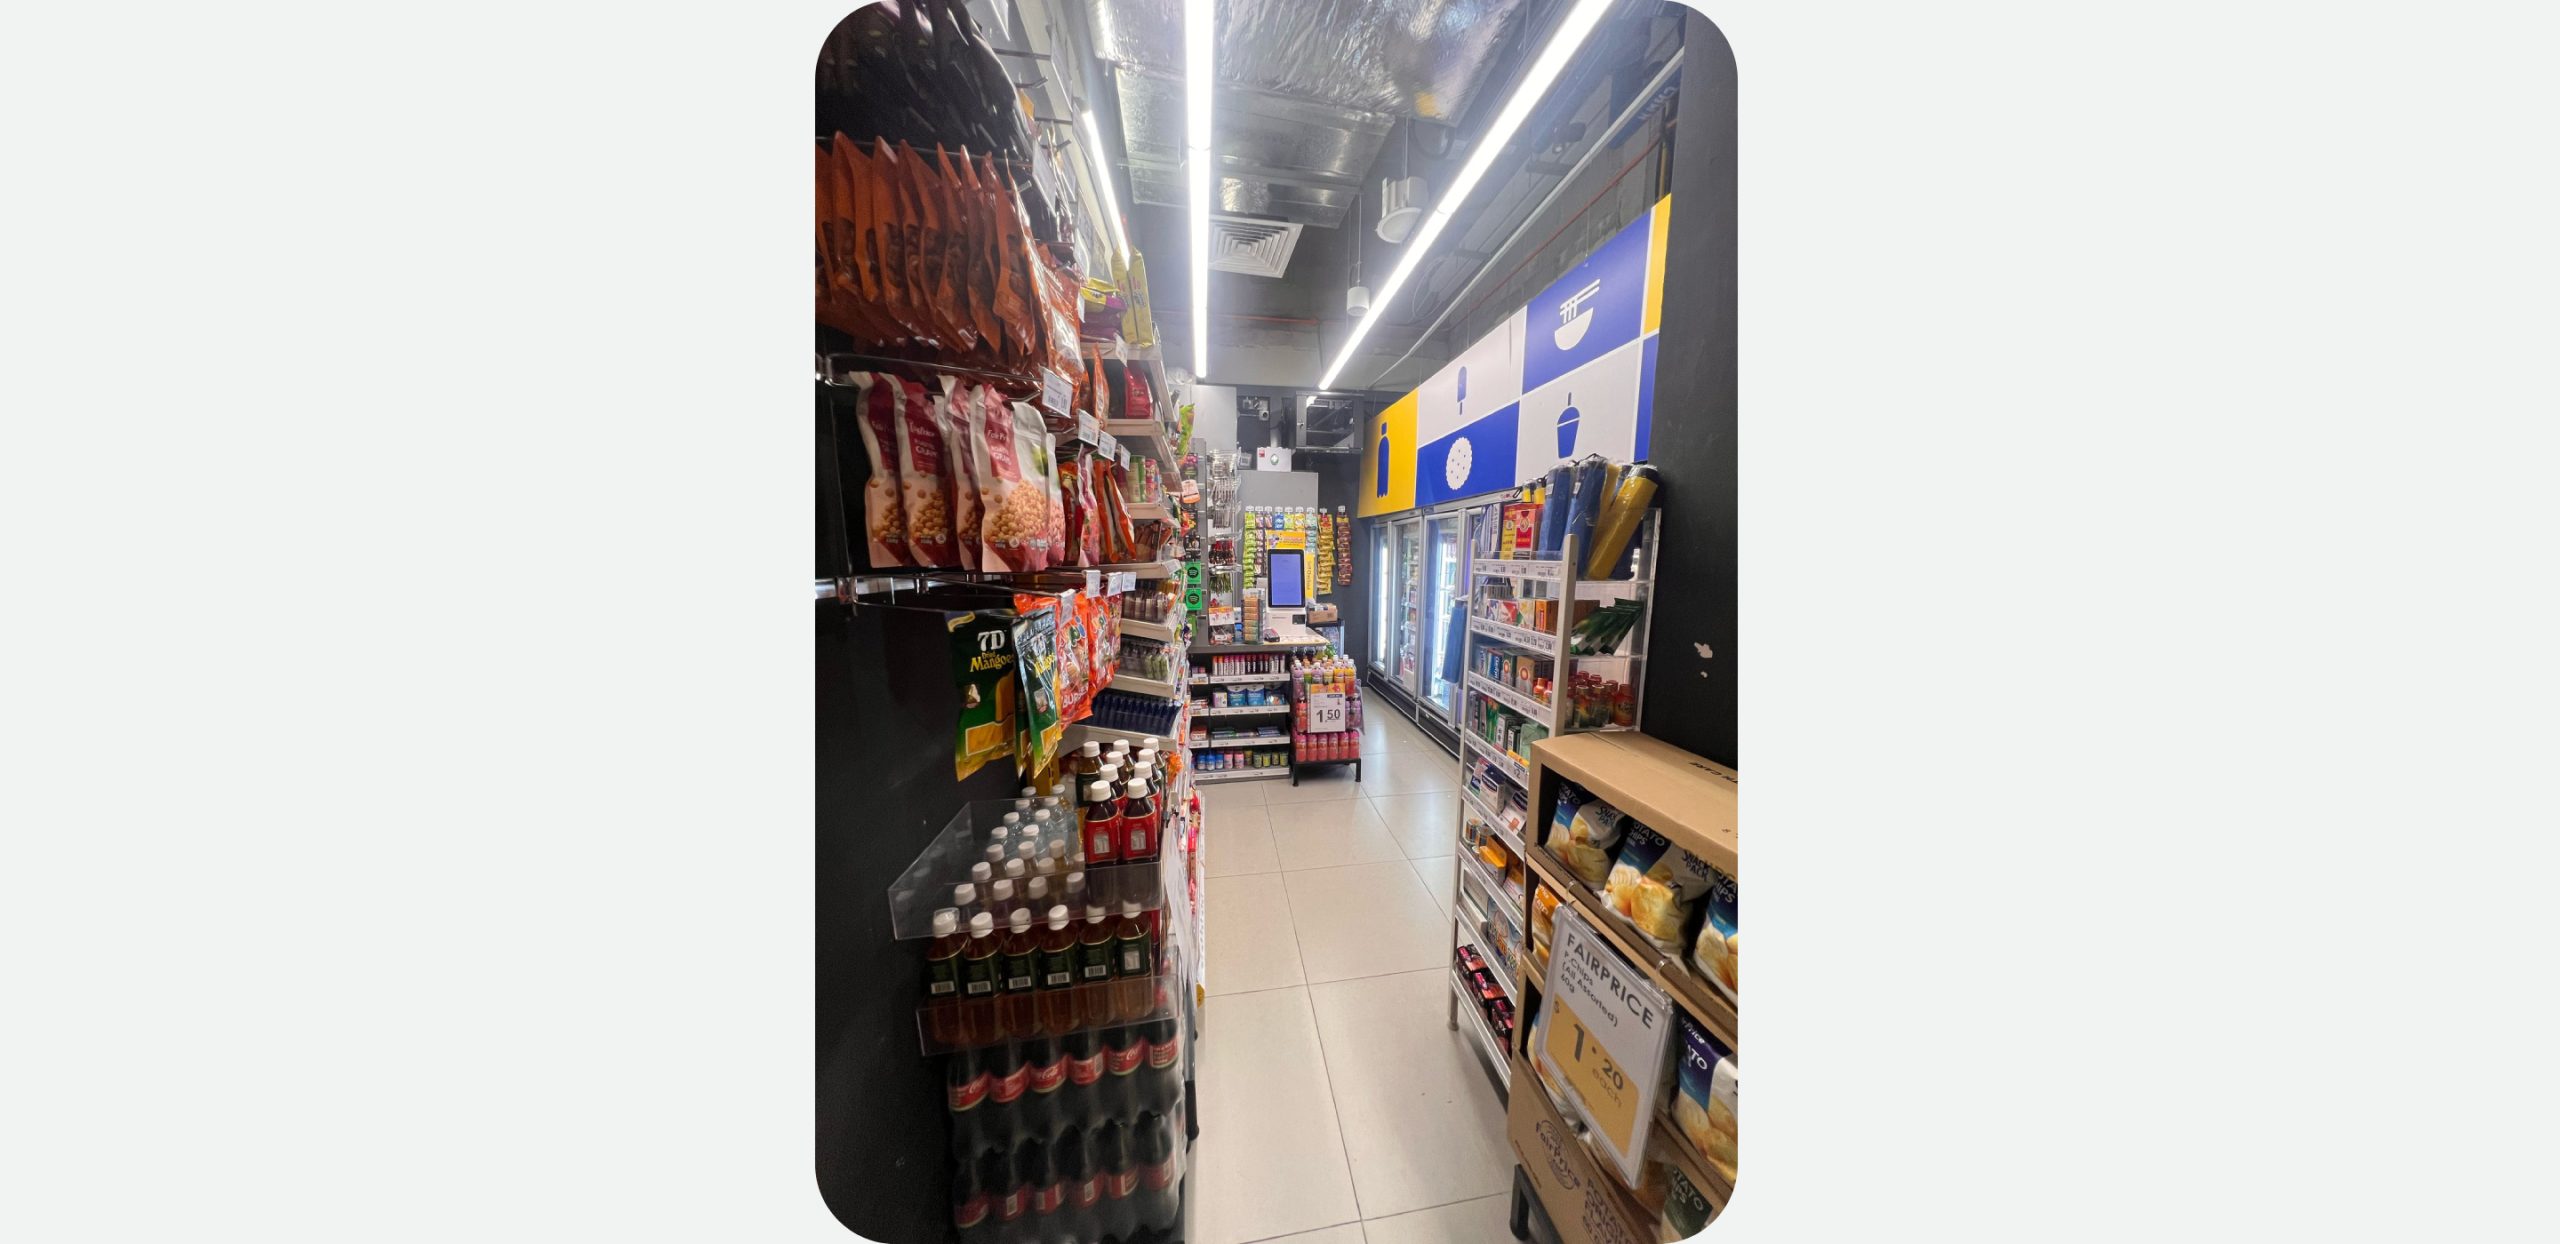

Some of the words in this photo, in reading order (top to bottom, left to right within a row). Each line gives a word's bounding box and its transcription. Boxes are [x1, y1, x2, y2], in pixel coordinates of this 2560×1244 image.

[977, 629, 1006, 652] 7D
[1316, 708, 1341, 723] 1.50
[1630, 829, 1648, 846] HIPS
[1633, 821, 1666, 847] OTATO
[1567, 933, 1654, 1029] FAIRPRICE
[1577, 979, 1618, 1028] Assorted)
[1592, 1068, 1623, 1108] each
